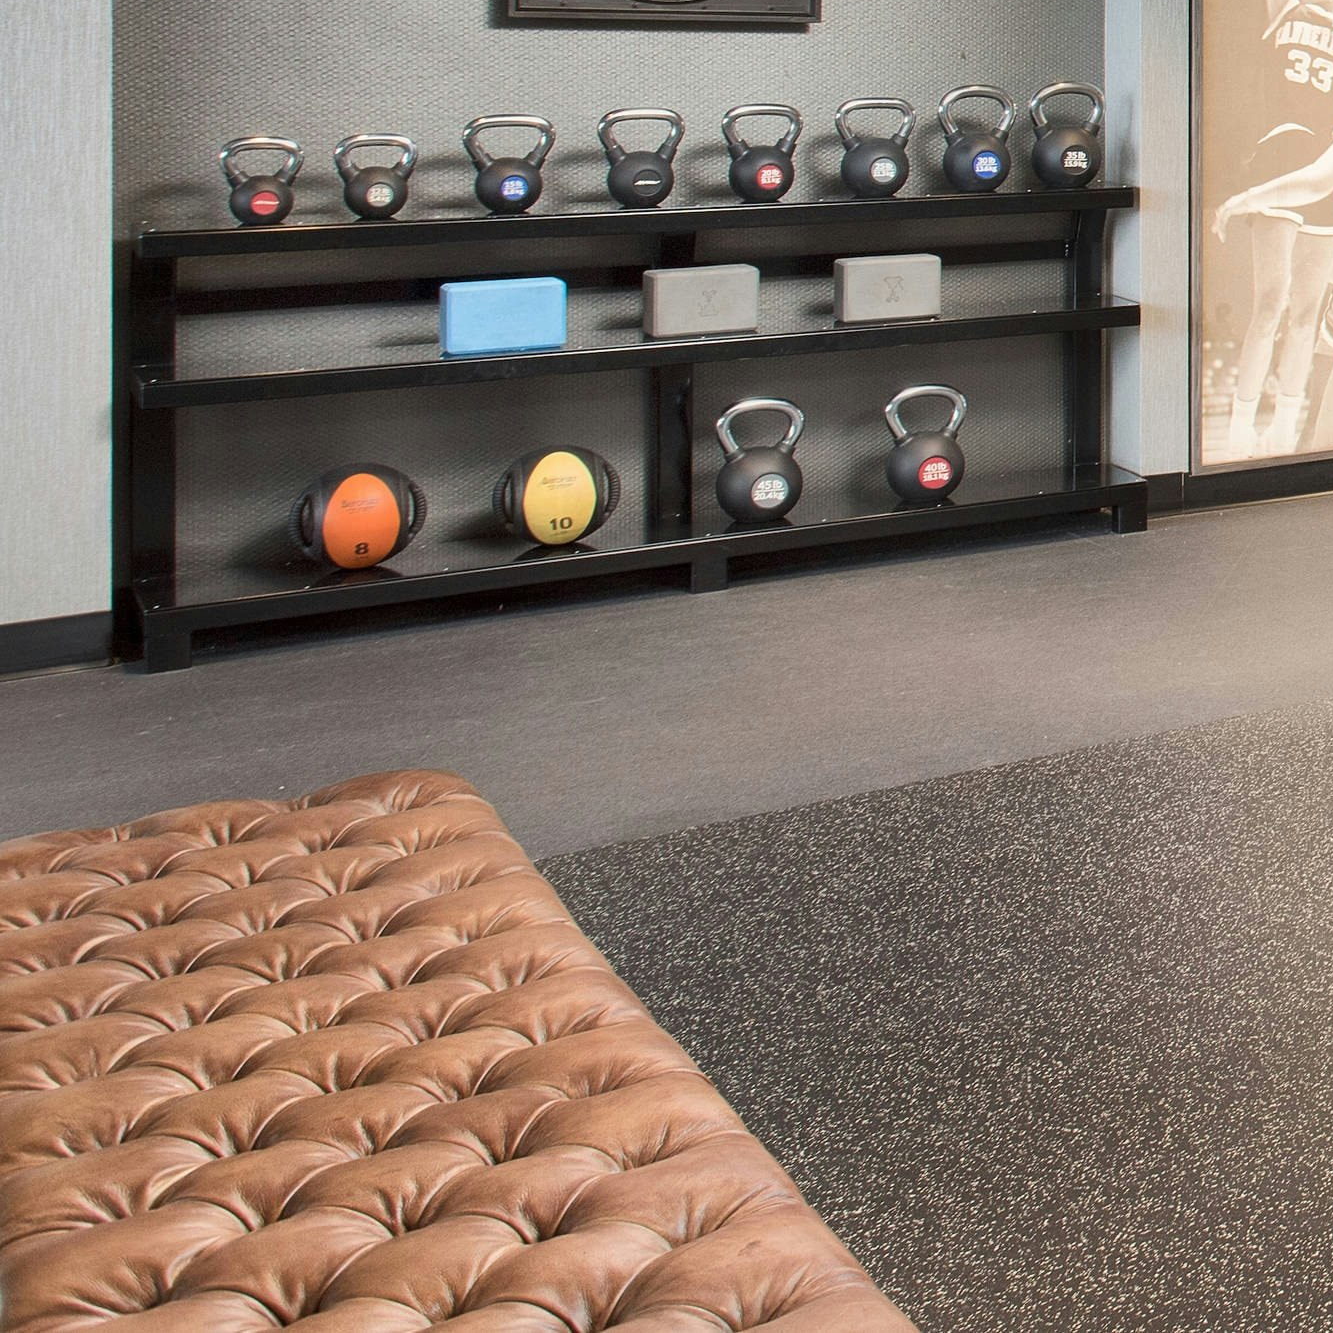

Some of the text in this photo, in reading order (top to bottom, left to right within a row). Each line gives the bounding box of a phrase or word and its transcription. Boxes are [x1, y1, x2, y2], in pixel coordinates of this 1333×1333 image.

[925, 463, 937, 472] 40
[758, 480, 772, 489] 45
[550, 517, 573, 531] 10
[355, 542, 369, 555] 8
